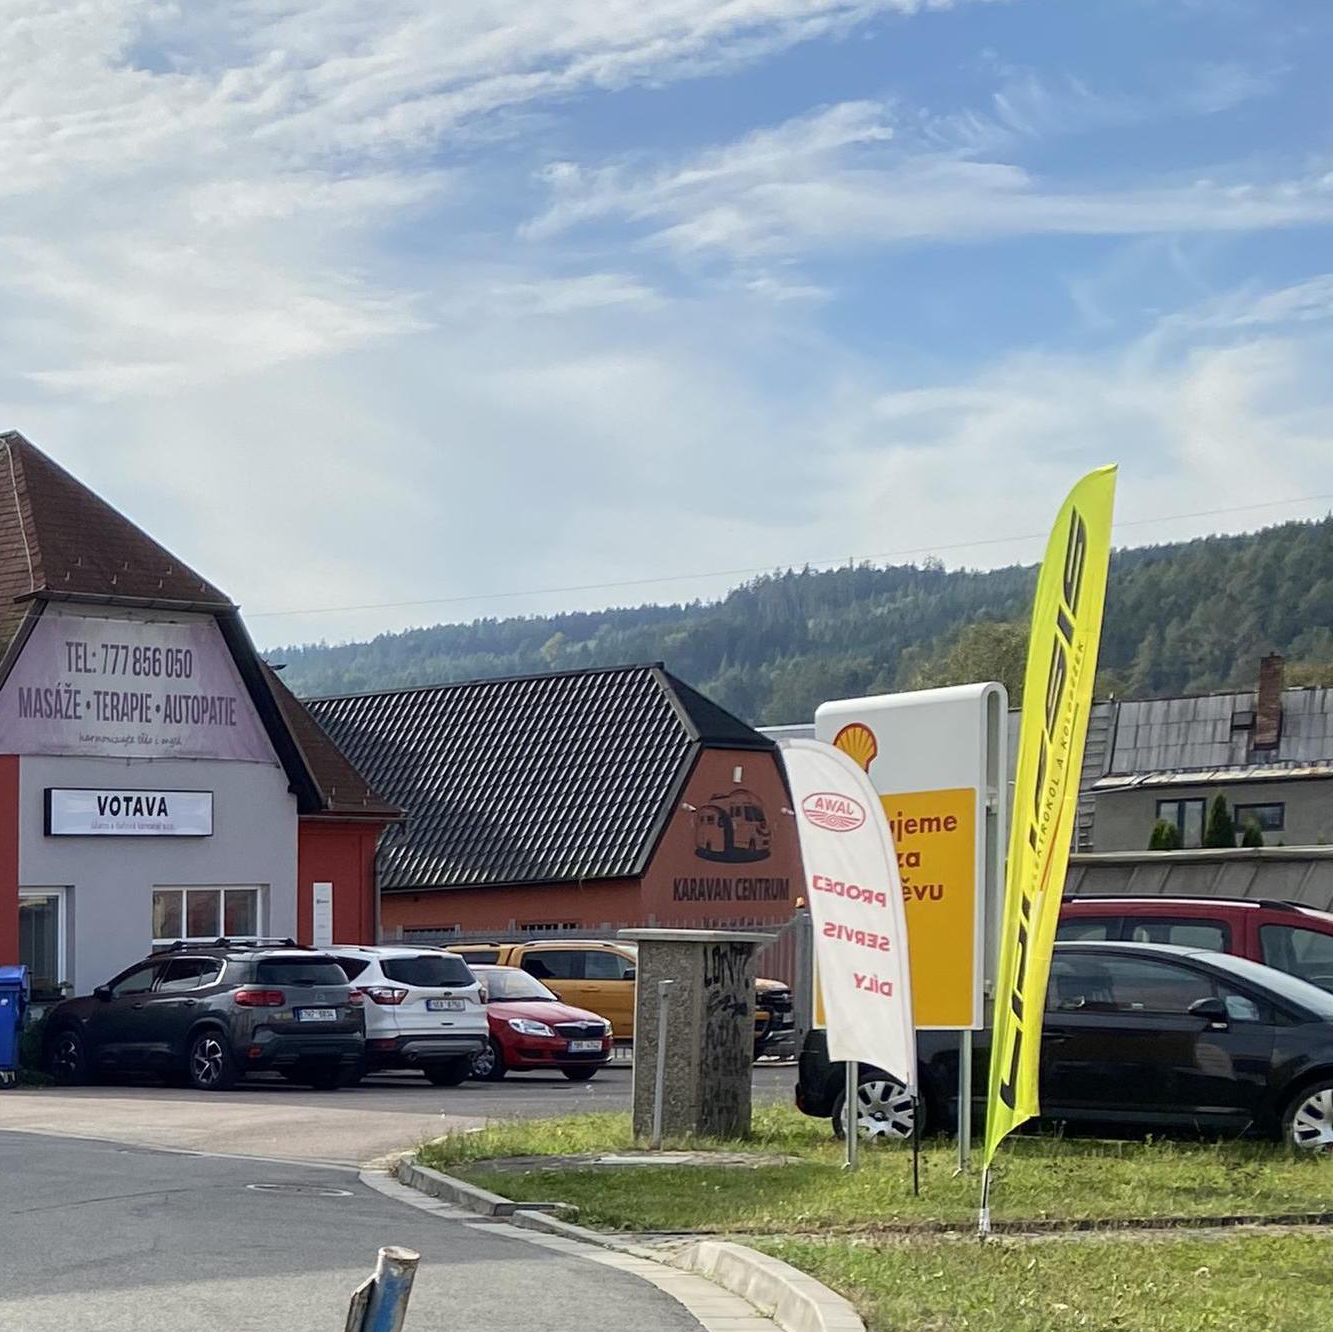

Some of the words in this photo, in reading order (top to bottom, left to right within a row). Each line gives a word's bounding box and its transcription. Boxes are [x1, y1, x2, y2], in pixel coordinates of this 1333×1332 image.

[65, 641, 96, 674] TEL:
[101, 644, 129, 676] 777
[133, 646, 162, 678] 856
[165, 649, 193, 679] 050
[18, 682, 82, 720] MASÁŽE
[93, 690, 152, 723] TERAPIE
[163, 694, 237, 726] AUTOPATIE
[97, 795, 169, 817] VOTAVA
[673, 877, 733, 900] KARAVAN
[735, 878, 789, 900] CENTRUM
